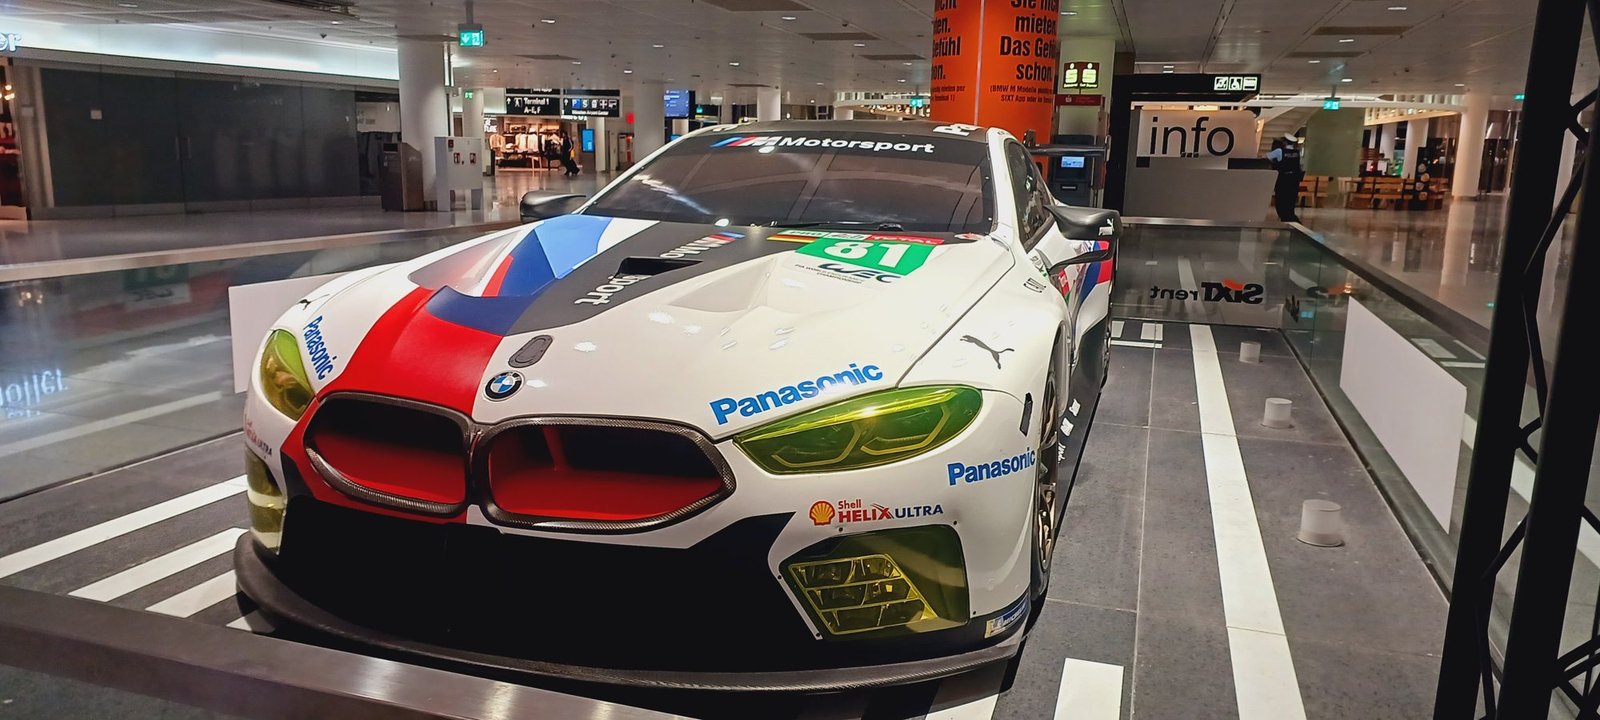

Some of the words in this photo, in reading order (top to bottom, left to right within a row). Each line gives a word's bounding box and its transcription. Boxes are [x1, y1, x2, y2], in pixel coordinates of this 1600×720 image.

[1000, 36, 1031, 56] Das
[524, 97, 545, 106] Terminal
[779, 137, 935, 154] Motorsport
[1150, 116, 1235, 156] info
[824, 241, 911, 268] 81
[818, 263, 902, 283] WEC
[303, 316, 337, 380] Panasonic
[710, 362, 884, 425] Panasonic
[948, 447, 1036, 486] Panasonic
[838, 499, 861, 510] Shell
[838, 503, 894, 523] HELIX
[895, 504, 943, 518] ULTRA
